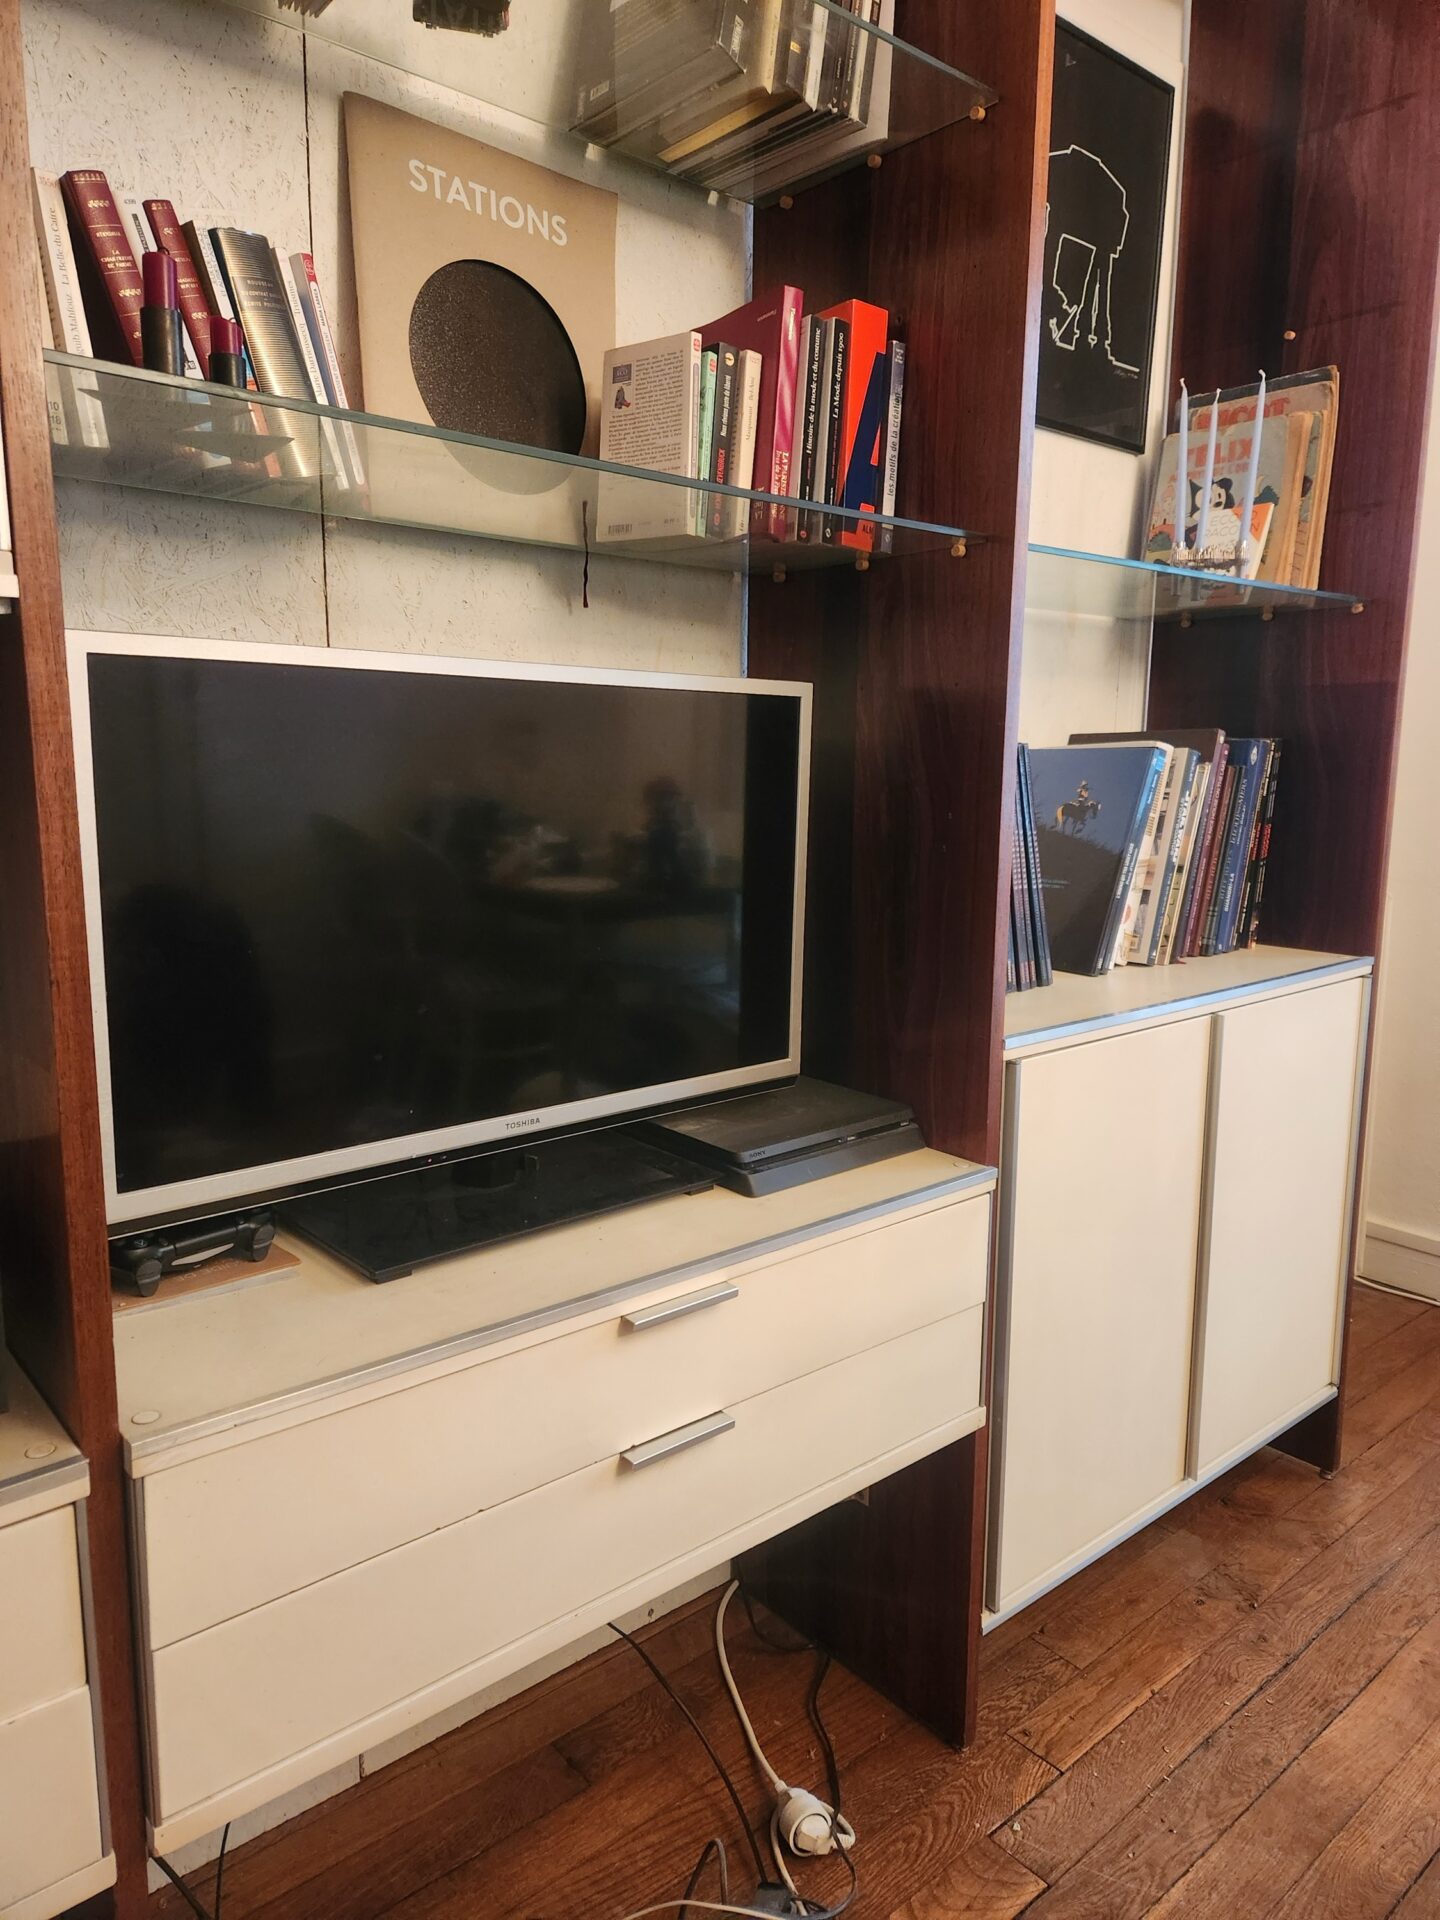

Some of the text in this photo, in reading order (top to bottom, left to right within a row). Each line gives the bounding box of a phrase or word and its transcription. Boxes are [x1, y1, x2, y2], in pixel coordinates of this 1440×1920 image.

[408, 159, 568, 247] STATIONS
[51, 234, 62, 247] du
[53, 248, 67, 272] Belle
[59, 273, 69, 286] La
[812, 327, 821, 360] costume
[811, 360, 818, 372] du
[811, 372, 817, 380] et
[832, 331, 844, 418] La Mode depuis 1900
[808, 380, 817, 403] mode
[807, 412, 814, 422] de
[805, 422, 814, 453] Histoire
[886, 391, 902, 496] les motifs de la création
[1224, 873, 1235, 912] SHANGRI-LA
[505, 1117, 541, 1131] TOSHIBA
[750, 1150, 766, 1158] SONY
